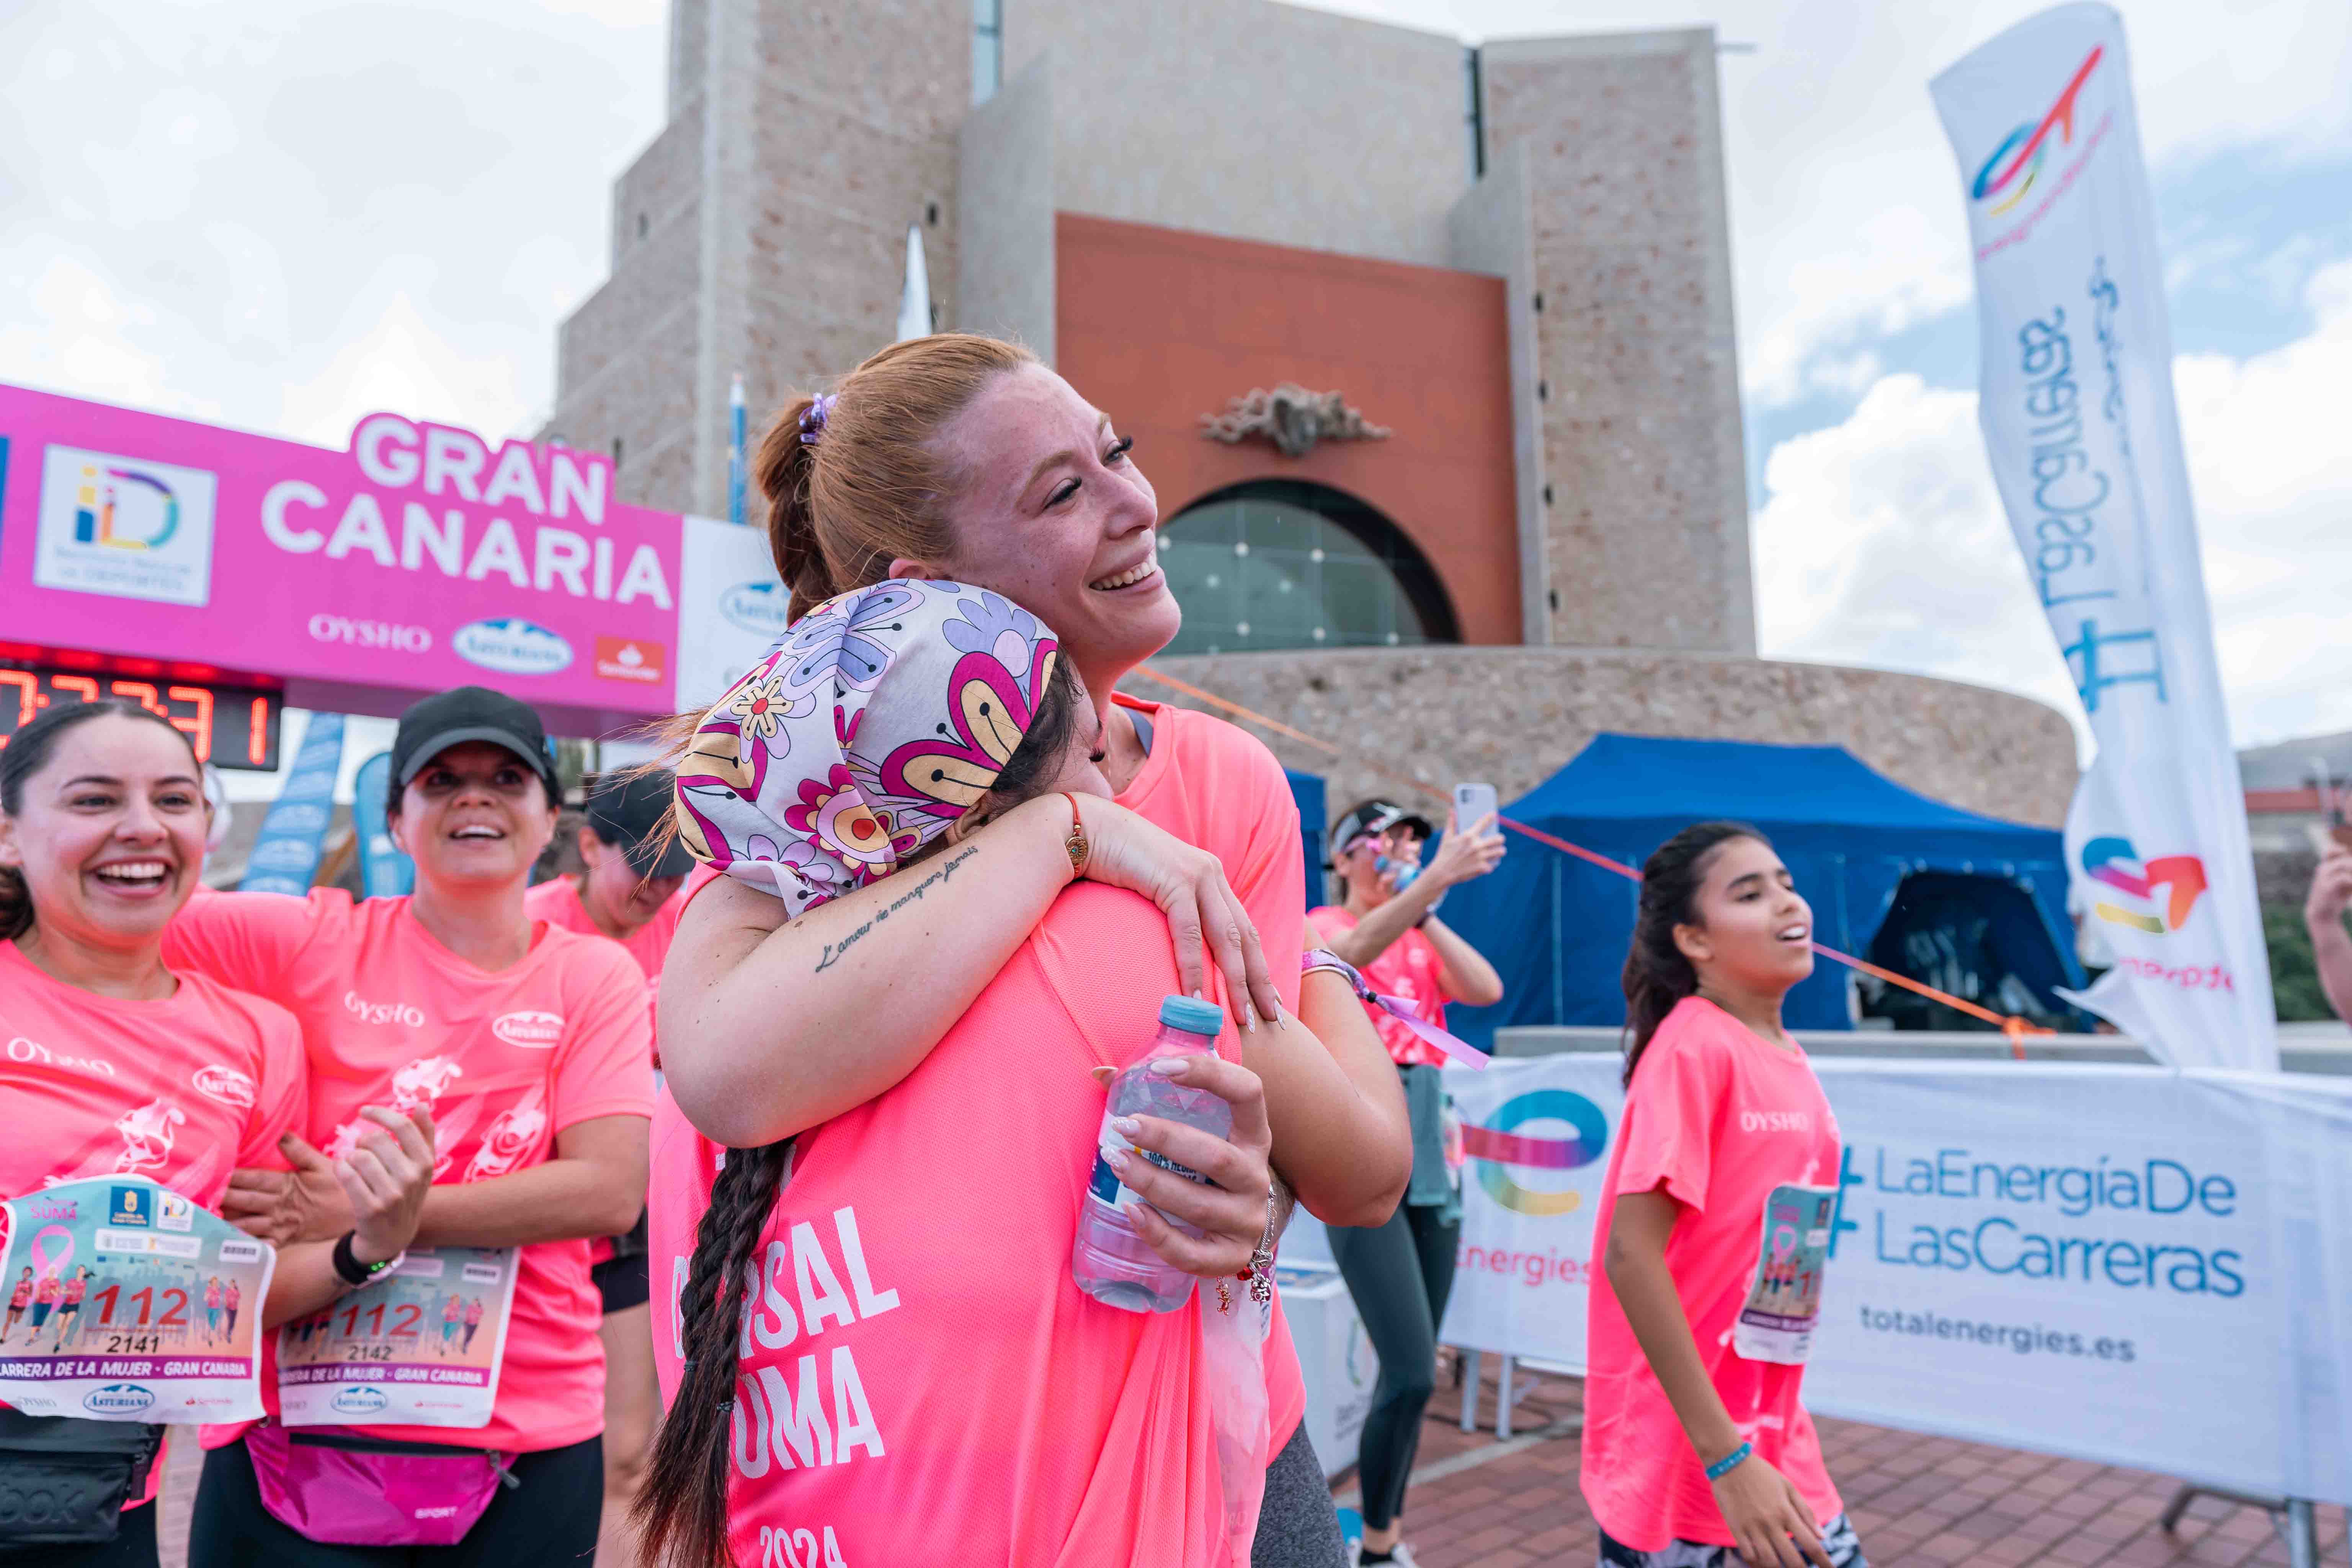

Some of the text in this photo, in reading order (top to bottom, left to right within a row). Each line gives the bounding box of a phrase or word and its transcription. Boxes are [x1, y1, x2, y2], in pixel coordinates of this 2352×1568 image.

[356, 417, 607, 526] GRAN
[261, 479, 673, 611] CANARIA
[308, 613, 432, 652] OYSHO
[1740, 1111, 1809, 1132] OYSHO
[30, 1206, 77, 1221] SUMA
[1875, 1210, 2246, 1298] LasCarreras
[671, 1205, 900, 1359] DRSAL
[93, 1285, 188, 1325] 112
[341, 1303, 422, 1337] 112
[106, 1335, 159, 1353] 2141
[348, 1345, 394, 1361] 2142
[1859, 1306, 2137, 1363] totalenergies.es
[0, 1361, 247, 1378] ARRERA DE LA MUJER GRAN CANARIA
[394, 1368, 429, 1379] GRAN
[430, 1370, 483, 1384] CANARIA
[732, 1345, 886, 1479] UMA
[415, 1506, 458, 1519] SPORT
[760, 1525, 848, 1568] 2024
